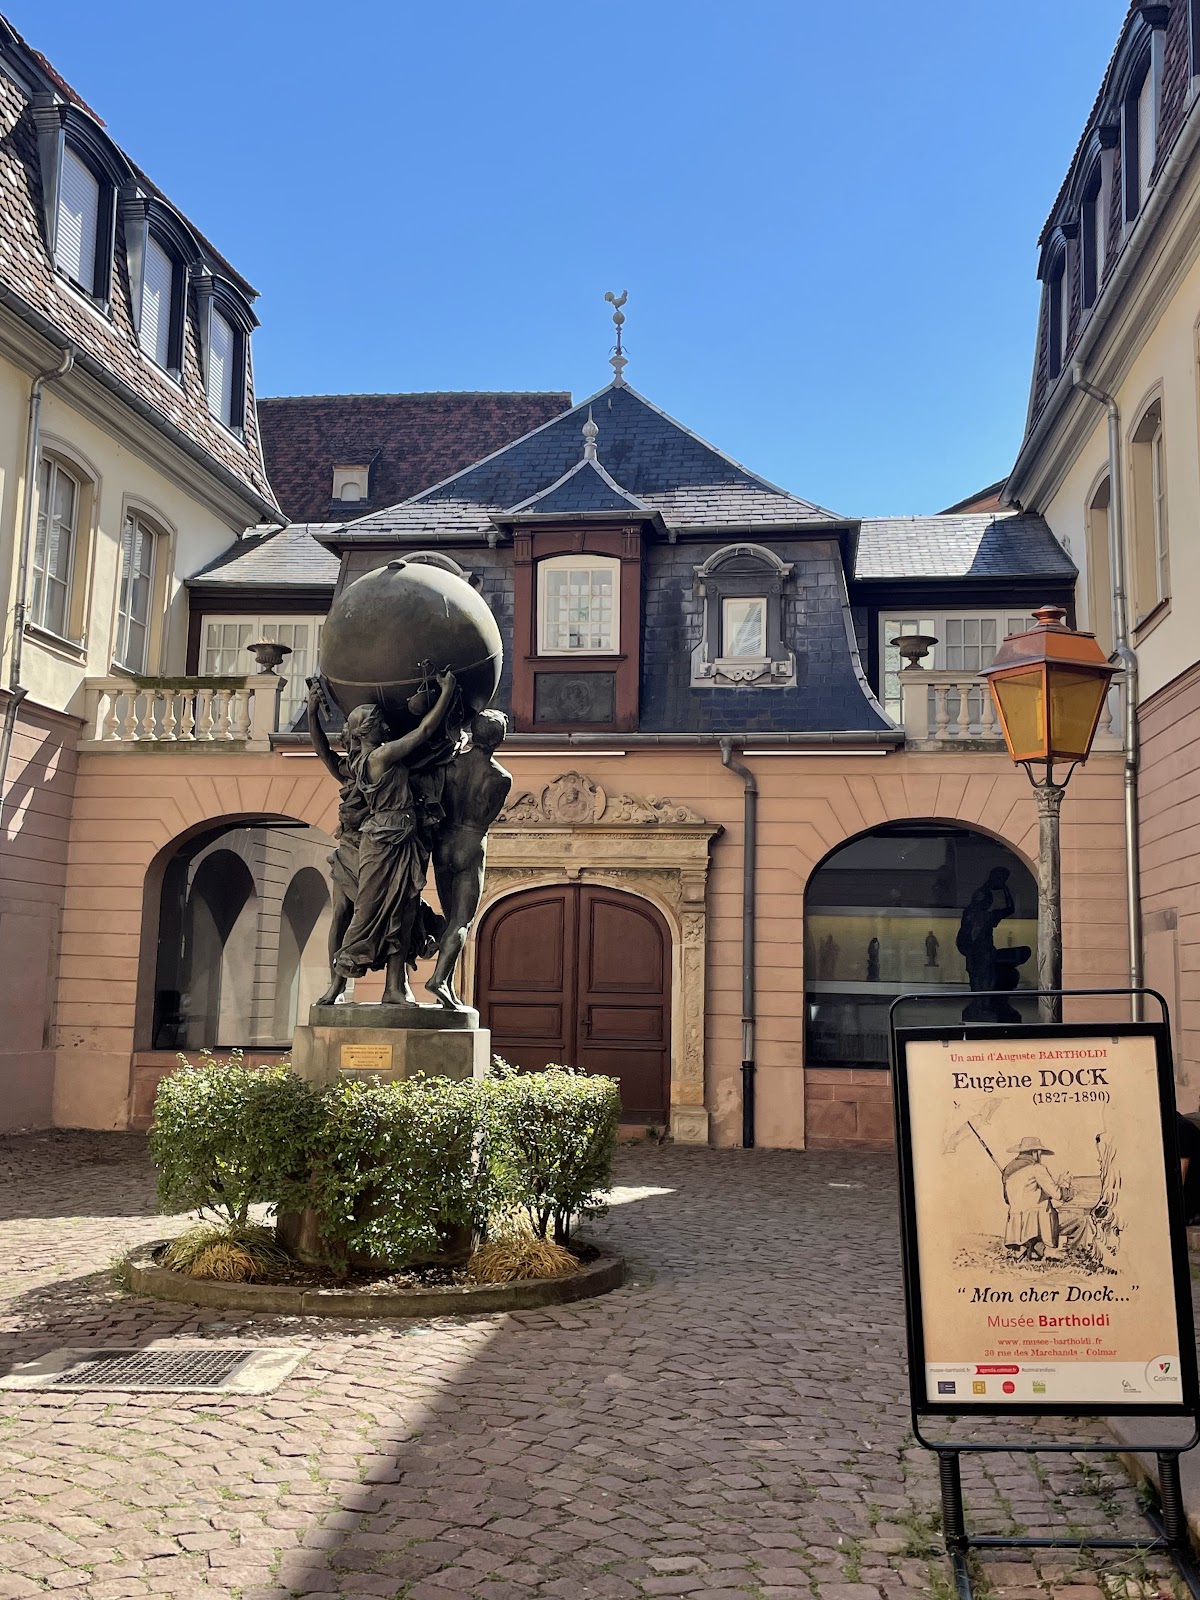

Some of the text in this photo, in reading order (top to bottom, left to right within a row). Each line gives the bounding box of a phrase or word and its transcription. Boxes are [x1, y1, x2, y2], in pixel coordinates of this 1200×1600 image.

[950, 1049, 1107, 1063] Un ami d'Auguste BARTHOLDI
[952, 1068, 1109, 1093] Eugène DOCK
[1032, 1090, 1111, 1105] (1827-1890)
[970, 1287, 1014, 1303] Mon
[1019, 1286, 1060, 1302] cher
[987, 1313, 1110, 1328] Musée Bartholdi
[1013, 1348, 1029, 1357] des
[1030, 1348, 1078, 1357] Marchands
[1086, 1348, 1118, 1356] Colmar
